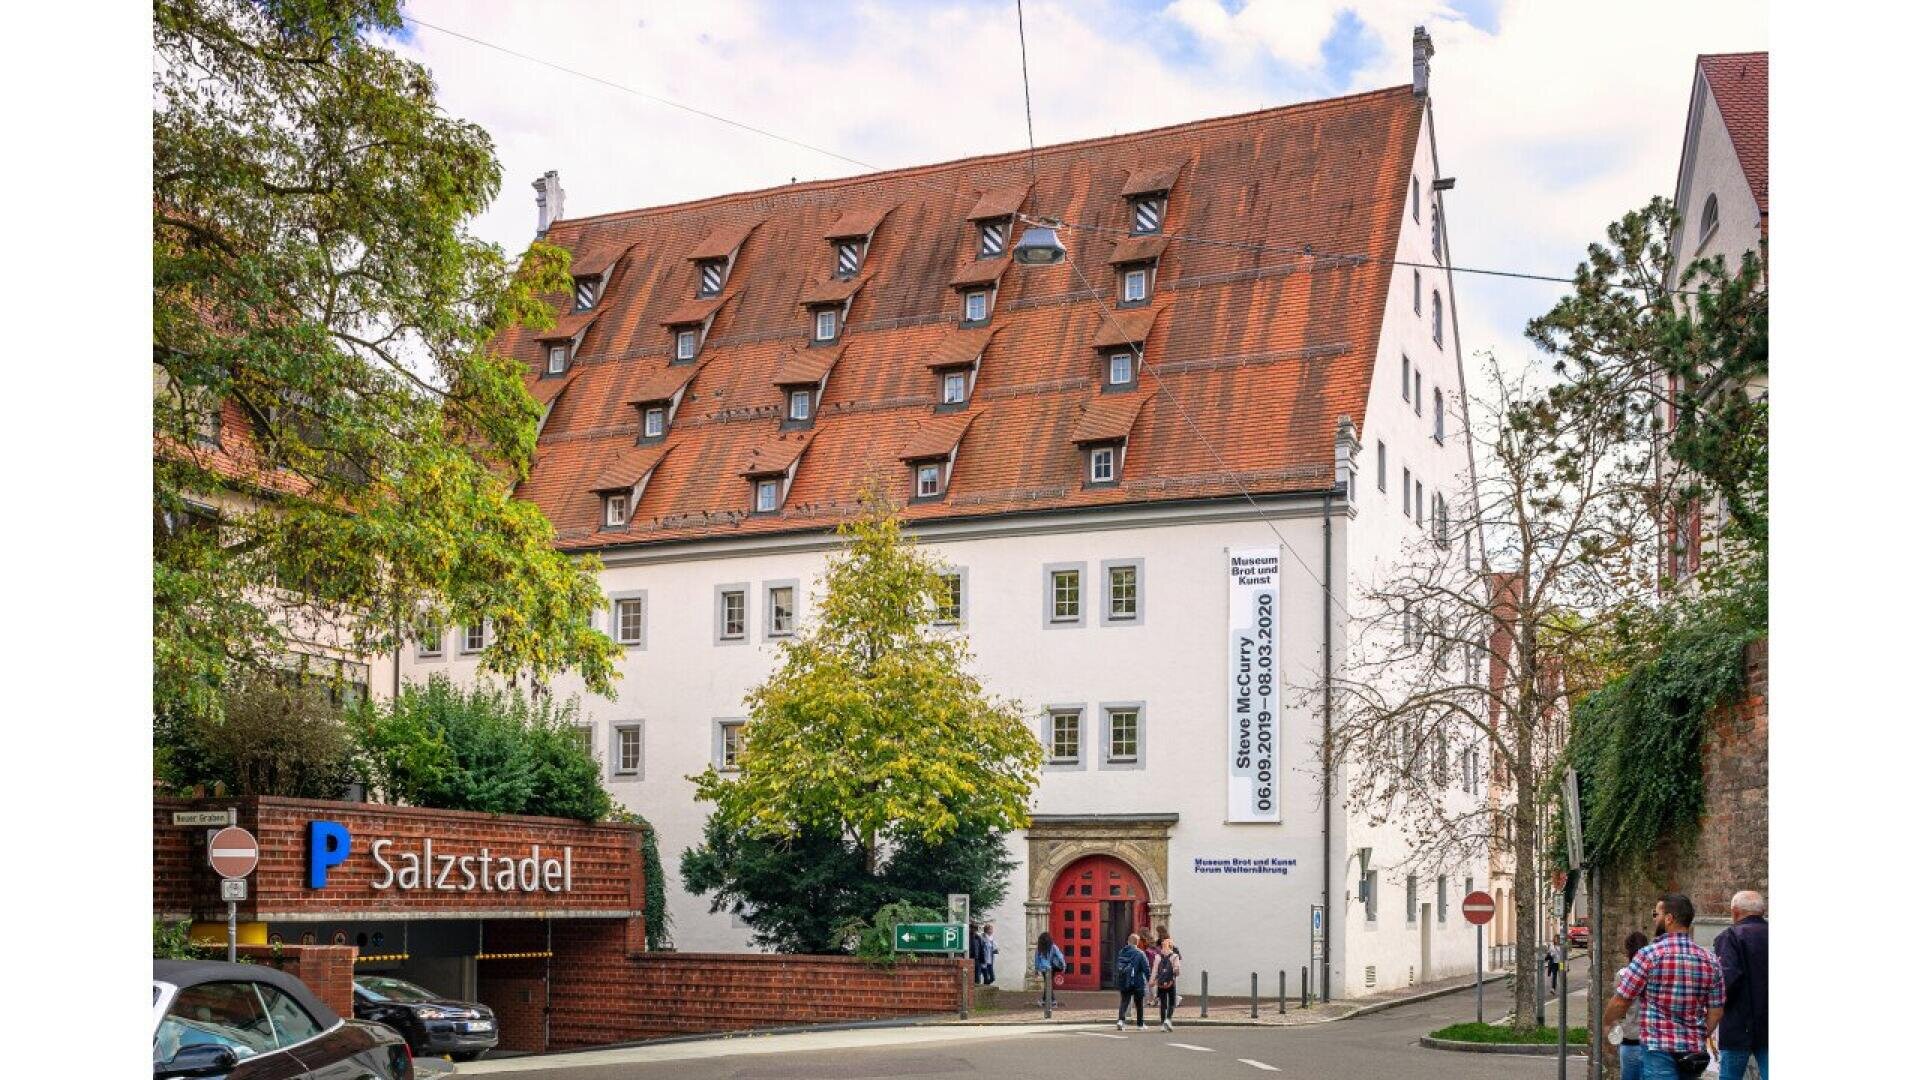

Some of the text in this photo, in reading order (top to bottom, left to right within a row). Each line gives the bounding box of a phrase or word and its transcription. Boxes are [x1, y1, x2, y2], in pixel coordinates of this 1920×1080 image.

[1231, 557, 1278, 566] Museum
[1232, 565, 1278, 576] Brot und
[1239, 576, 1271, 585] Kunst
[1236, 636, 1254, 769] Steve McCurry
[176, 814, 224, 822] Neuer Graben
[307, 820, 351, 889] P
[370, 838, 572, 892] Salzstadel
[1195, 858, 1297, 866] Museum Brot und Kunst
[1223, 866, 1288, 875] Welternährung
